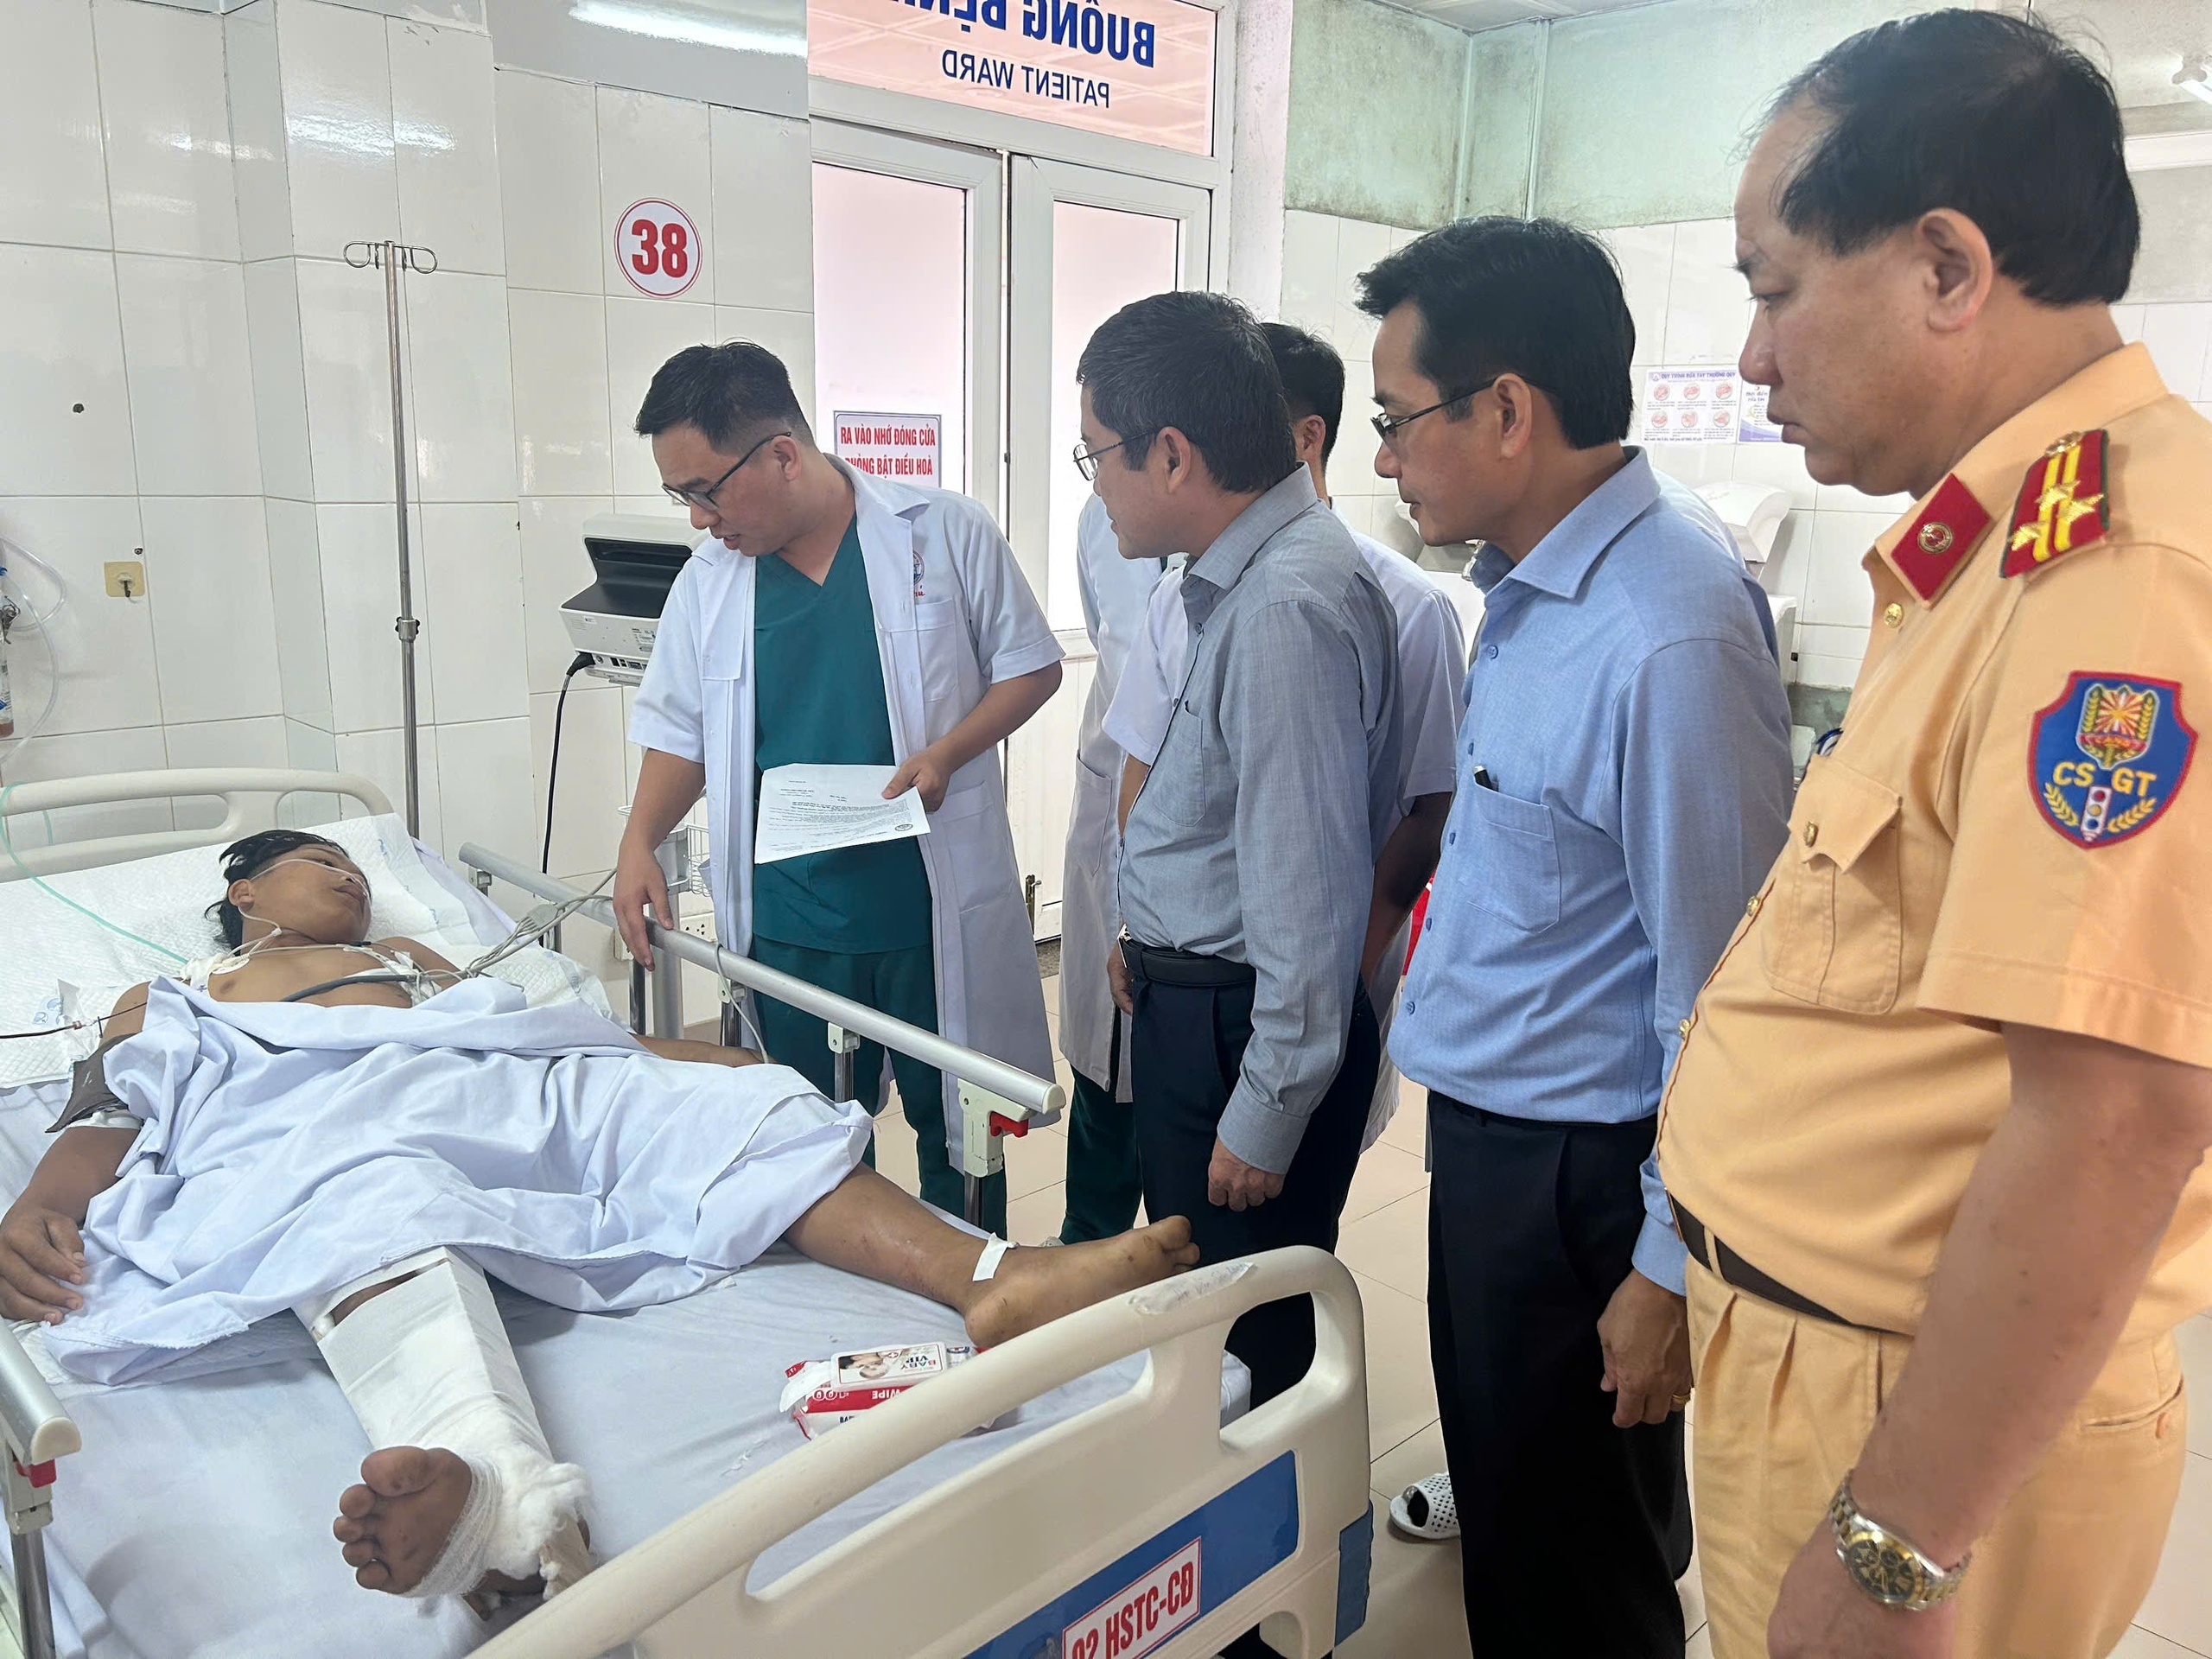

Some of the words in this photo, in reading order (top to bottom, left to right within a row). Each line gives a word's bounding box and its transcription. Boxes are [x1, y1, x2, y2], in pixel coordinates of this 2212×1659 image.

[632, 219, 688, 278] 38
[841, 427, 852, 444] RA
[855, 423, 871, 445] VÀO
[874, 423, 892, 445] NHỚ
[894, 424, 917, 446] ĐÓNG
[919, 423, 936, 446] CỬA
[877, 454, 893, 479] BẬT
[917, 454, 933, 475] HOÀ
[2053, 760, 2096, 787] CS
[2111, 767, 2158, 797] GT
[1105, 1560, 1194, 1659] HSTC-CĐ
